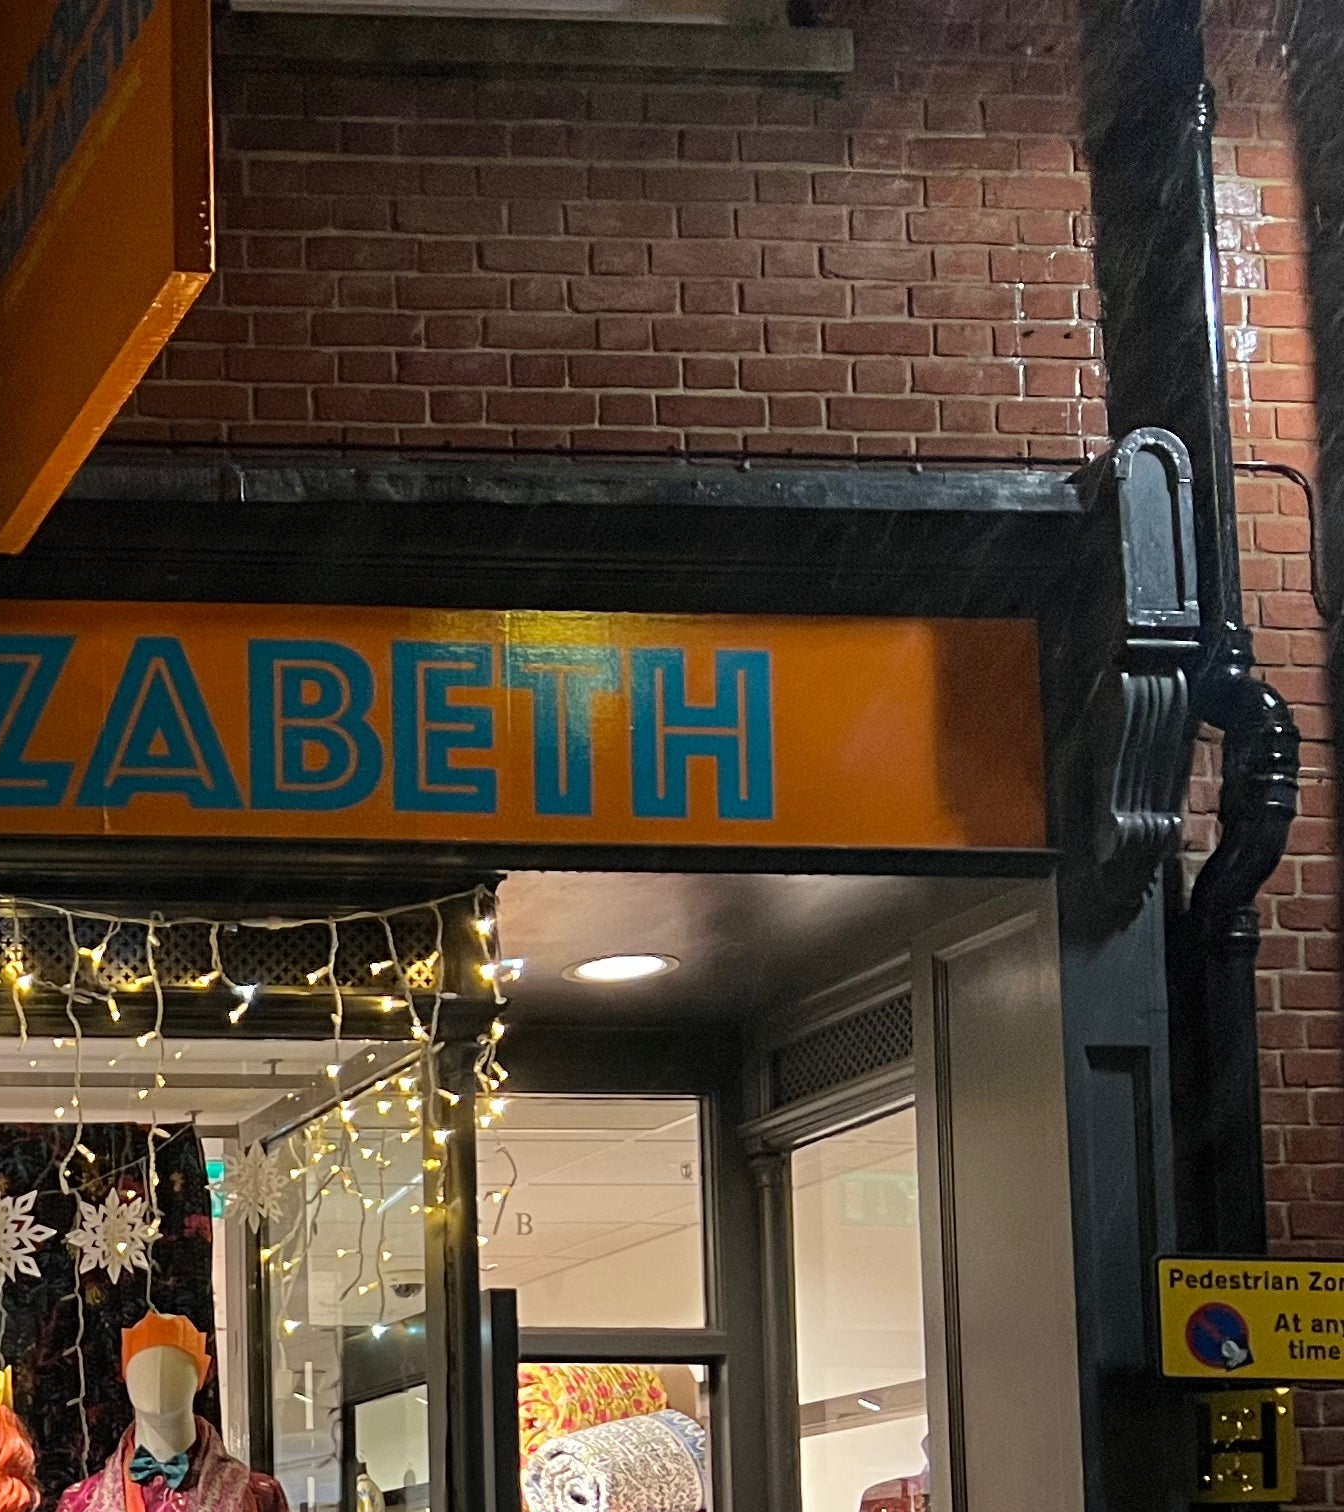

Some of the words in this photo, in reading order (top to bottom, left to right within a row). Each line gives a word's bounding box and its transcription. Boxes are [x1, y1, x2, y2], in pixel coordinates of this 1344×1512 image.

[1169, 1269, 1299, 1291] Pedestrian
[1275, 1314, 1301, 1332] At
[1289, 1340, 1340, 1360] time
